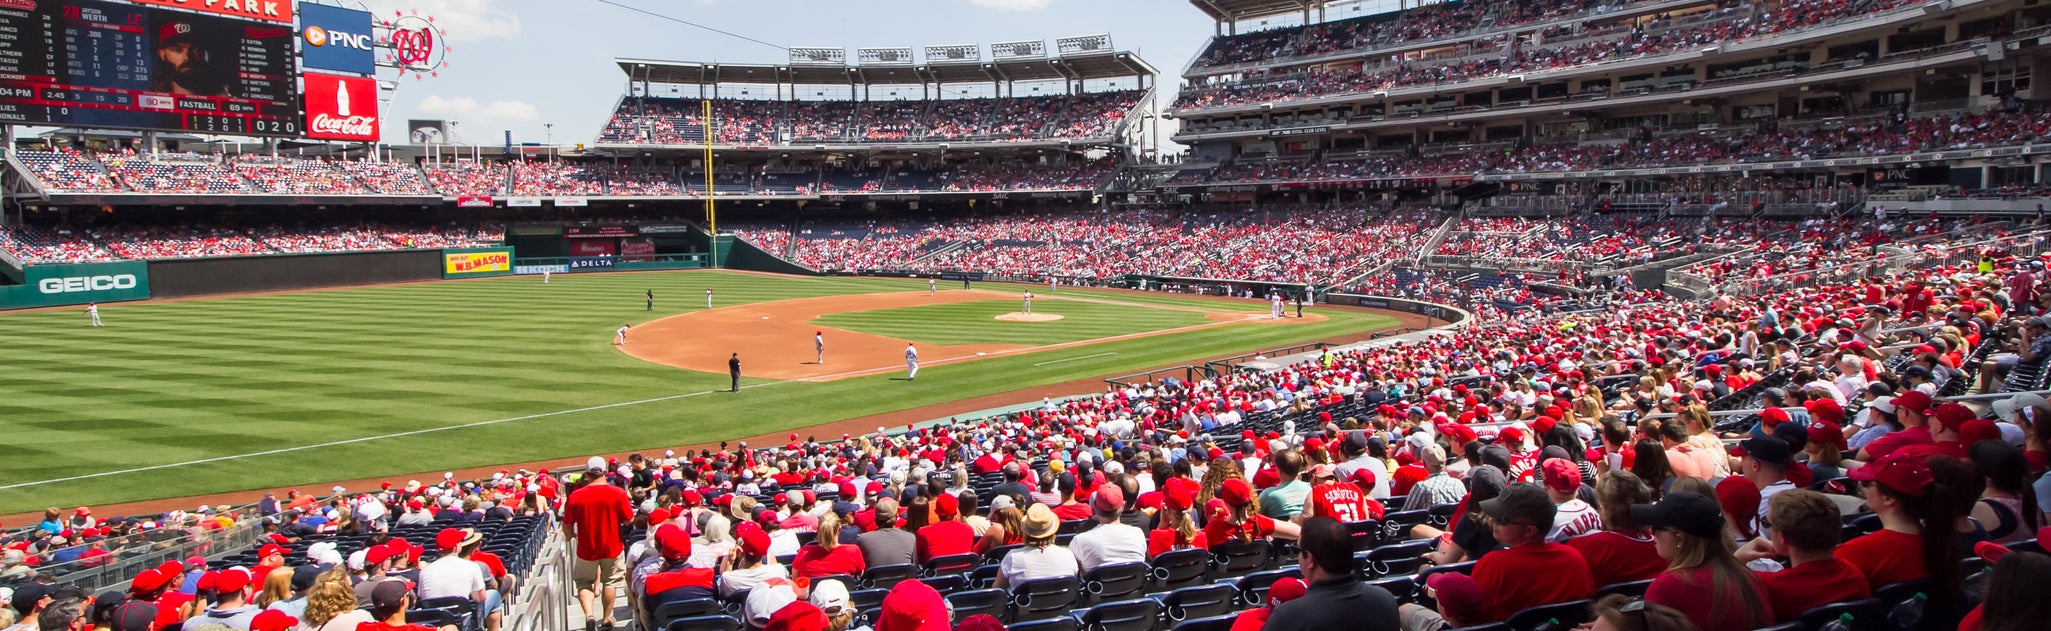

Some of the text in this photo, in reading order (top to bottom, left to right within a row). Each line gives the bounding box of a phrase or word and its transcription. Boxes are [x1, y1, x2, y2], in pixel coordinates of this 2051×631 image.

[64, 4, 80, 18] 28
[82, 14, 108, 22] WERTH
[128, 13, 142, 25] LF
[328, 30, 372, 50] PNC
[392, 28, 432, 64] W
[16, 89, 32, 98] PM
[146, 98, 158, 106] 90
[180, 100, 216, 110] FASTBALL
[256, 120, 294, 132] 0 2 0
[312, 114, 375, 136] Coca-Cola
[1888, 168, 1910, 179] PNC
[530, 264, 563, 274] KOCH
[39, 274, 136, 294] GEICO
[1562, 510, 1602, 537] HARPE
